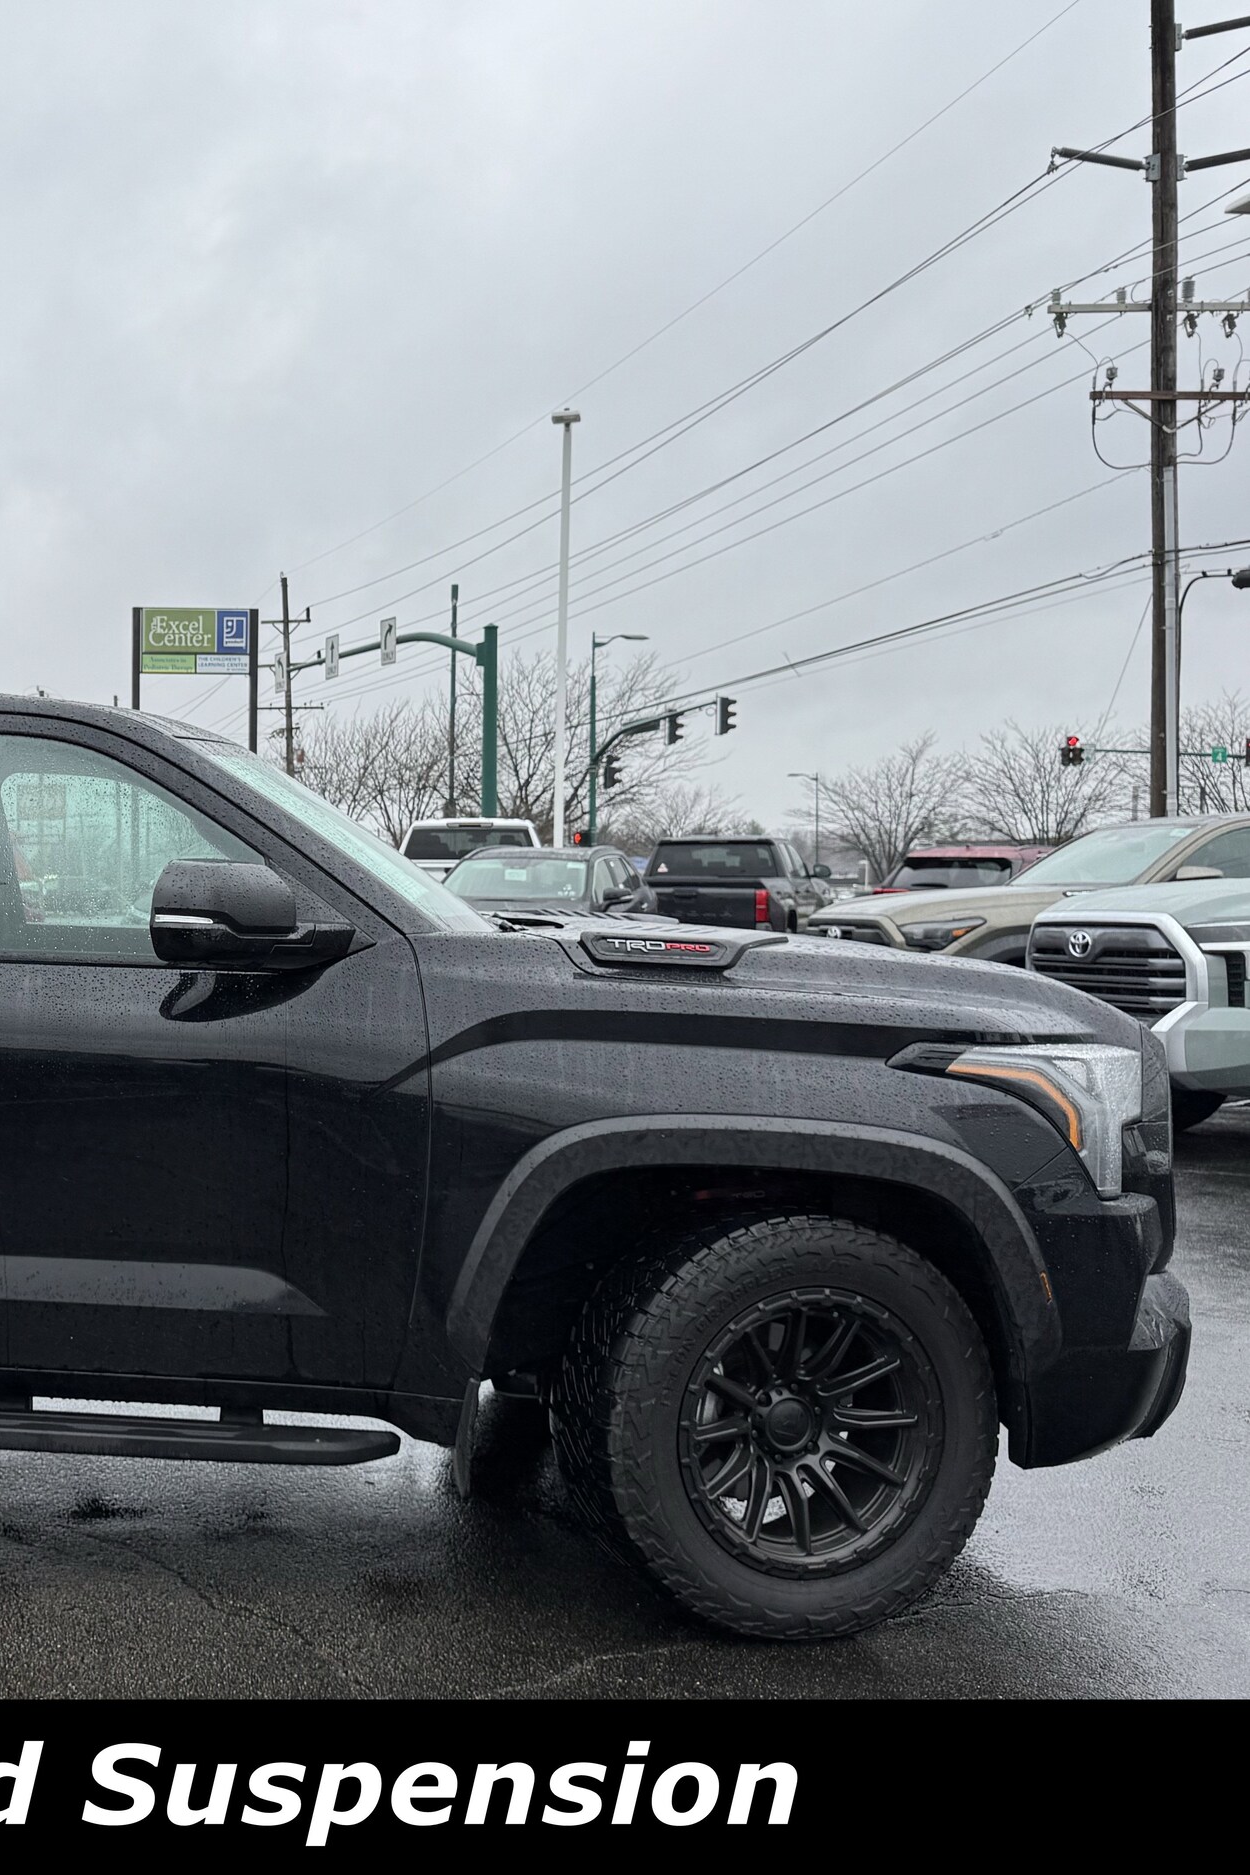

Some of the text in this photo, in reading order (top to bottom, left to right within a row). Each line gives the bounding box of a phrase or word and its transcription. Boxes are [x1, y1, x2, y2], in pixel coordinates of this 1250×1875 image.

[156, 616, 204, 634] Excel
[149, 631, 212, 647] Center
[606, 938, 711, 953] TRD PRO
